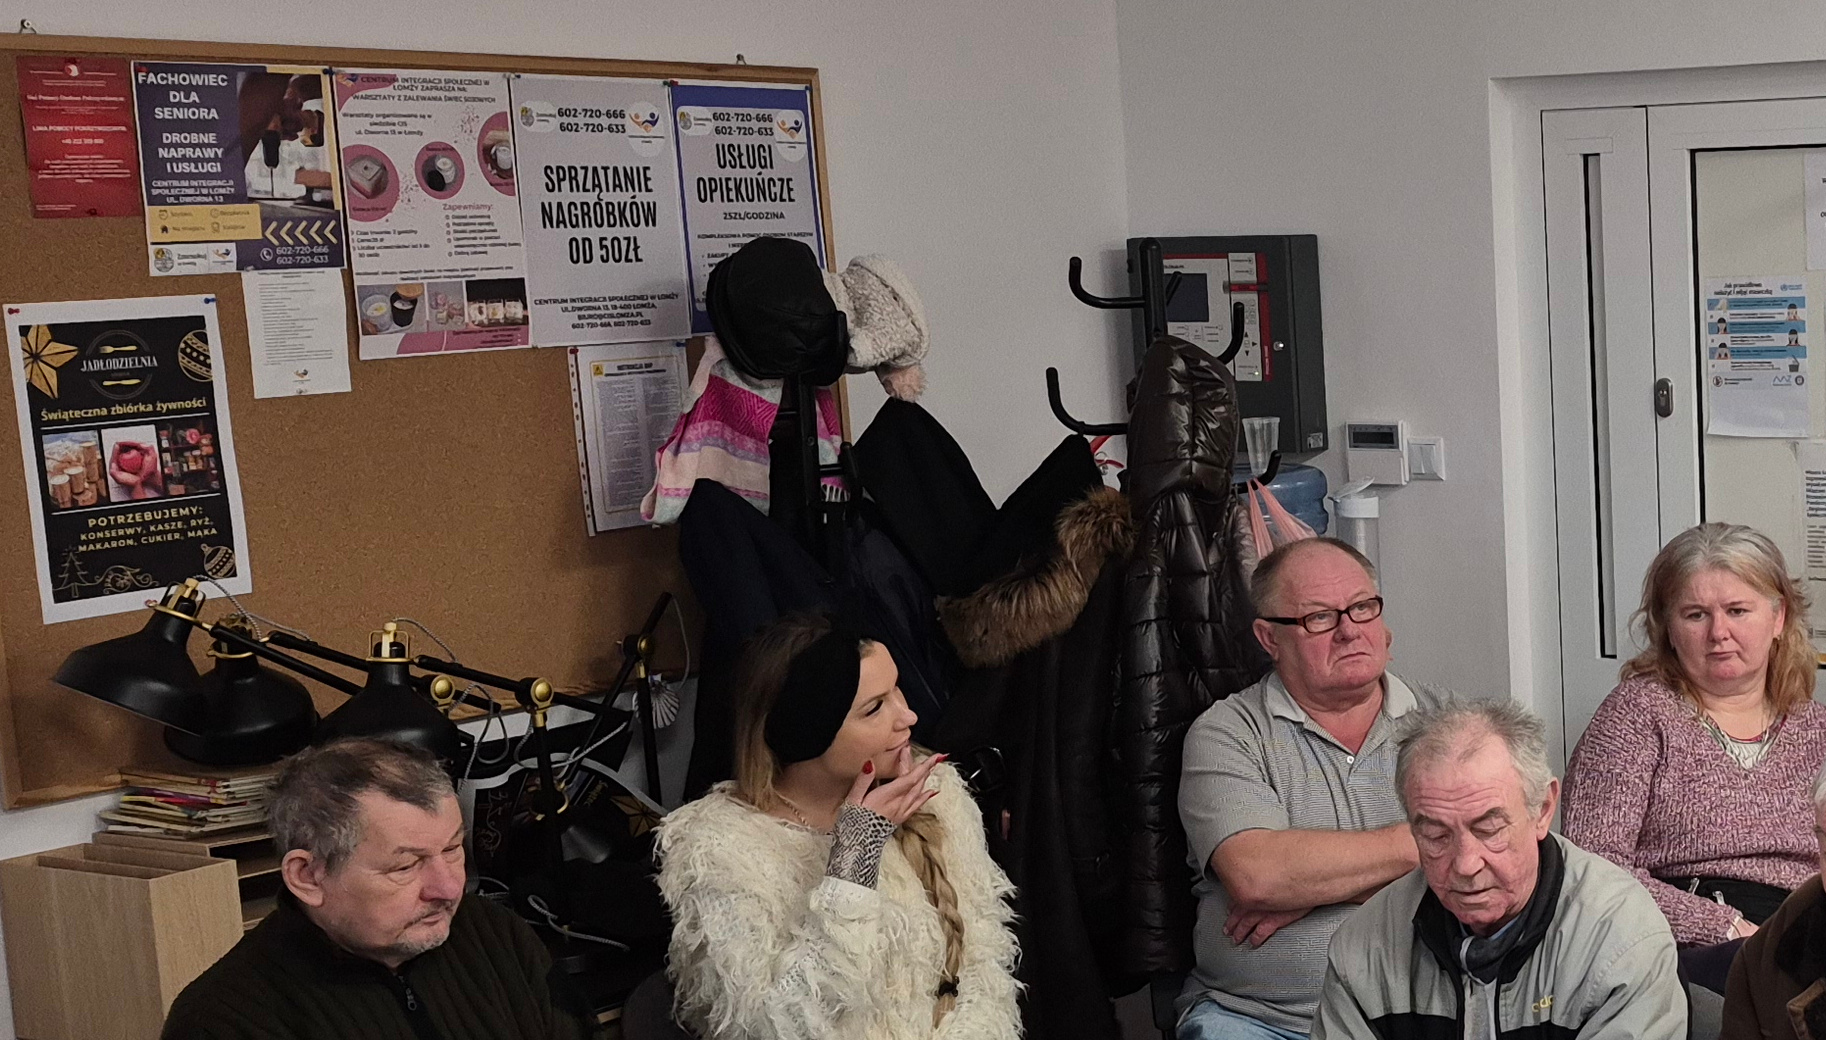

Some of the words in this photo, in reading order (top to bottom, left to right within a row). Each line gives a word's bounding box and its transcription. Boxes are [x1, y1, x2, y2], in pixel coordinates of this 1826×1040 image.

[138, 72, 228, 86] FACHOWIEC
[169, 90, 200, 103] DLA
[154, 107, 219, 120] SENIORA
[557, 107, 626, 120] 602-720-666
[712, 112, 774, 123] 602-720-666
[559, 122, 627, 134] 602-720-633
[714, 126, 775, 137] 602-720-633
[162, 132, 218, 144] DROBNE
[158, 147, 224, 159] NAPRAWY
[715, 143, 775, 170] USŁUGI
[166, 162, 172, 173] I
[172, 162, 222, 173] USŁUGI
[543, 164, 654, 202] SPRZĄTANIE
[696, 171, 796, 204] OPIEKUŃCZE
[723, 210, 786, 221] 25ZŁ/GODZINA
[568, 236, 594, 265] OD
[599, 235, 644, 264] 50ZŁ
[80, 355, 158, 372] JADŁODZIELNIA
[40, 407, 108, 422] Świąteczna
[110, 402, 154, 416] zbiórka
[155, 396, 207, 412] żywności
[88, 505, 204, 528] POTRZEBUJEMY:
[80, 526, 147, 541] KONSERWY,
[78, 537, 138, 553] MAKARON,
[141, 532, 185, 544] CUKIER,
